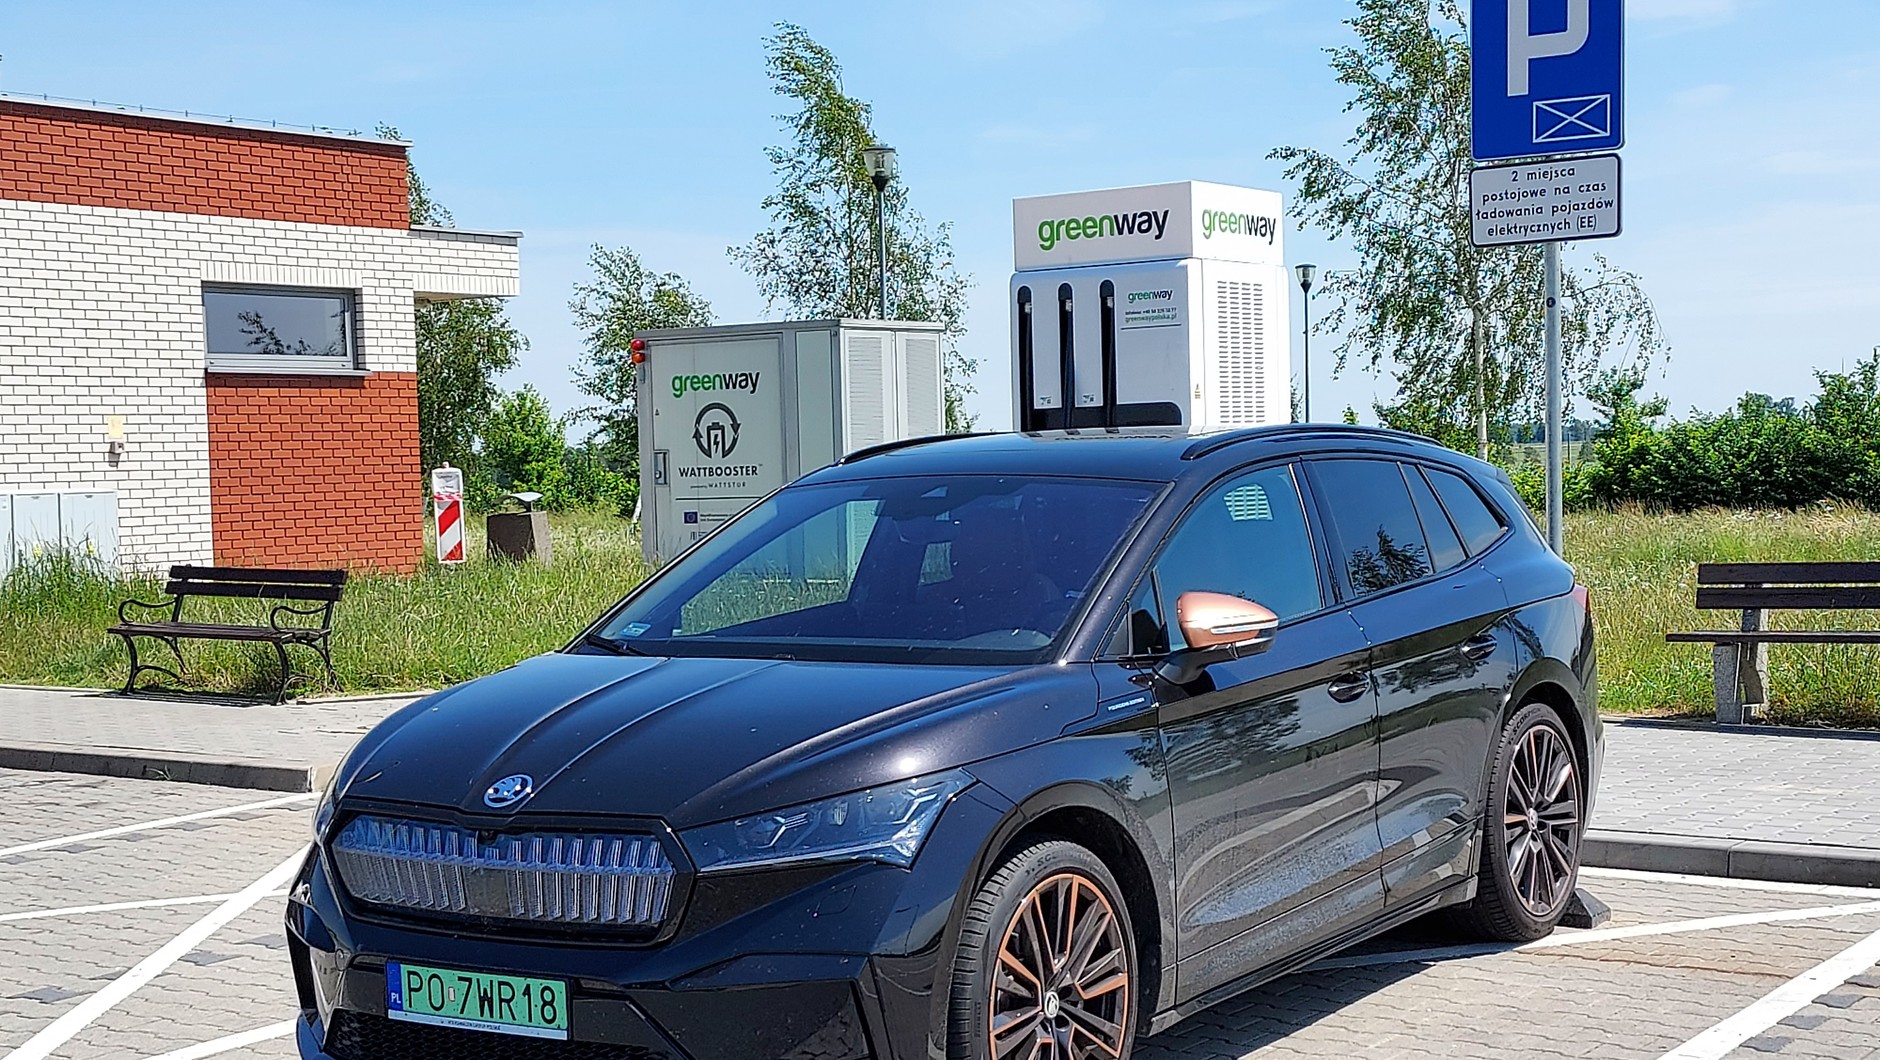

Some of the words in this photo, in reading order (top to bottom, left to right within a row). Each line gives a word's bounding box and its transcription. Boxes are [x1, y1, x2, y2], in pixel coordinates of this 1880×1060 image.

[1507, 0, 1589, 97] P
[1511, 170, 1519, 181] 2
[1526, 167, 1575, 181] miejsca
[1482, 187, 1547, 206] postojowe
[1554, 186, 1570, 196] na
[1578, 182, 1607, 193] czas
[1475, 204, 1544, 220] ładowania
[1551, 197, 1614, 216] pojazdów
[1038, 209, 1170, 251] greenway
[1202, 208, 1276, 245] greenway
[1487, 218, 1571, 237] elektrycznych
[1576, 214, 1597, 232] (EE)
[1128, 290, 1173, 304] greenway
[671, 371, 760, 398] greenway
[678, 465, 758, 477] WATTBOOSTER
[391, 992, 401, 1004] PL
[407, 970, 445, 1012] PO
[457, 976, 557, 1025] 7WR18
